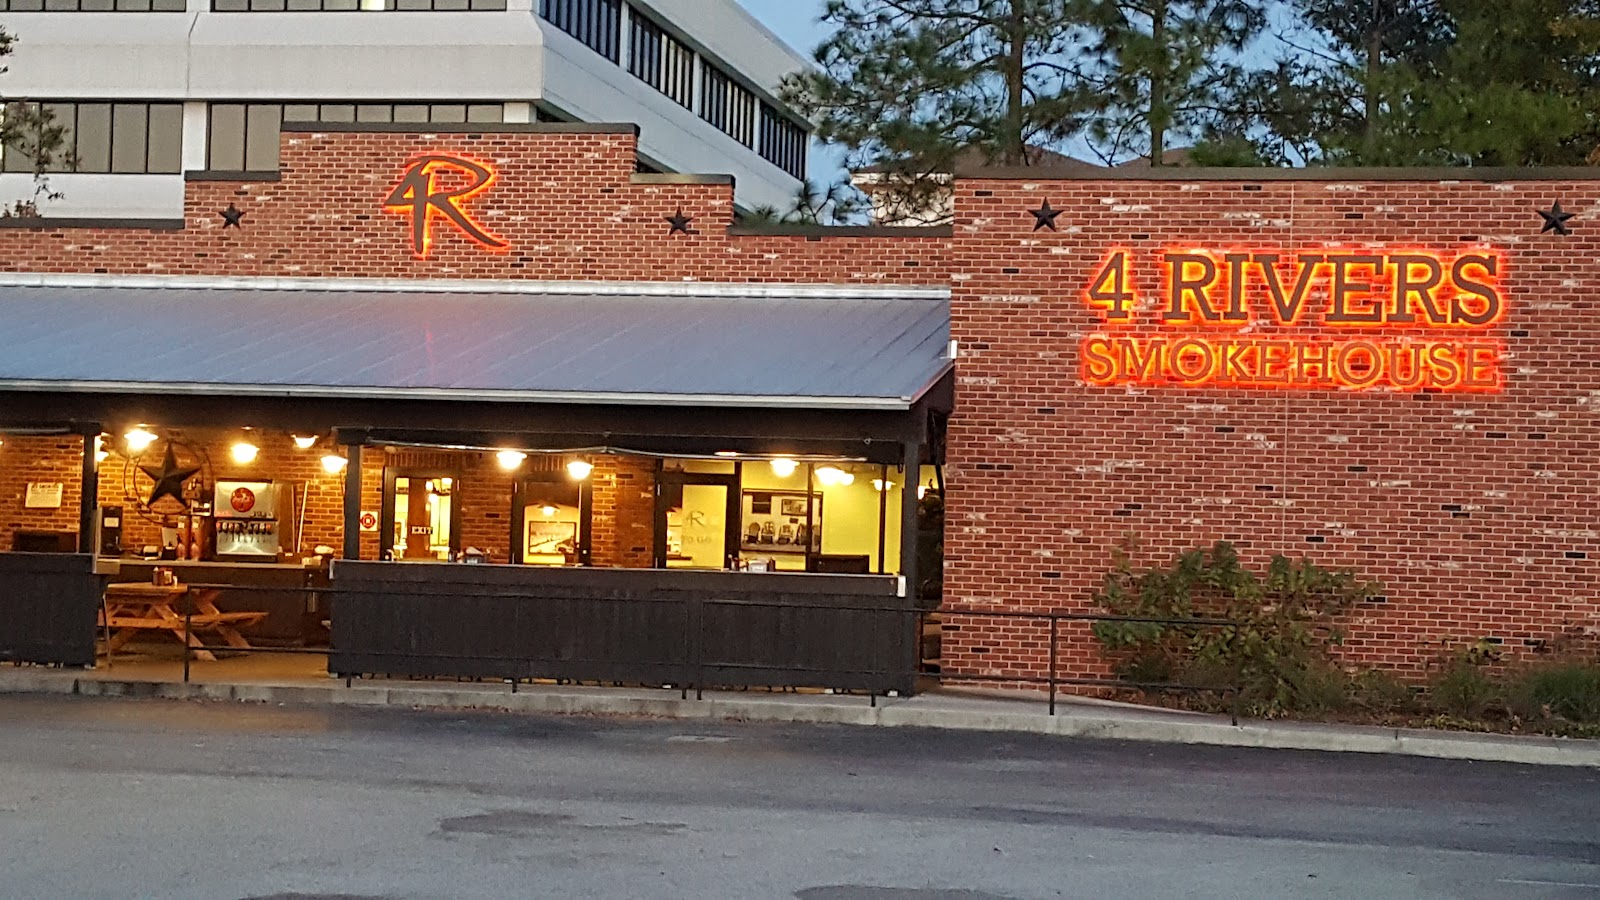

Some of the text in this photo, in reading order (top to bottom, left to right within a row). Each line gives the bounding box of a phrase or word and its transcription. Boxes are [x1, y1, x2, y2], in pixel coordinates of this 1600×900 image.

[1087, 252, 1500, 324] 4 RIVERS
[1084, 338, 1498, 387] SMOKEHOUSE
[411, 525, 433, 535] EXIT
